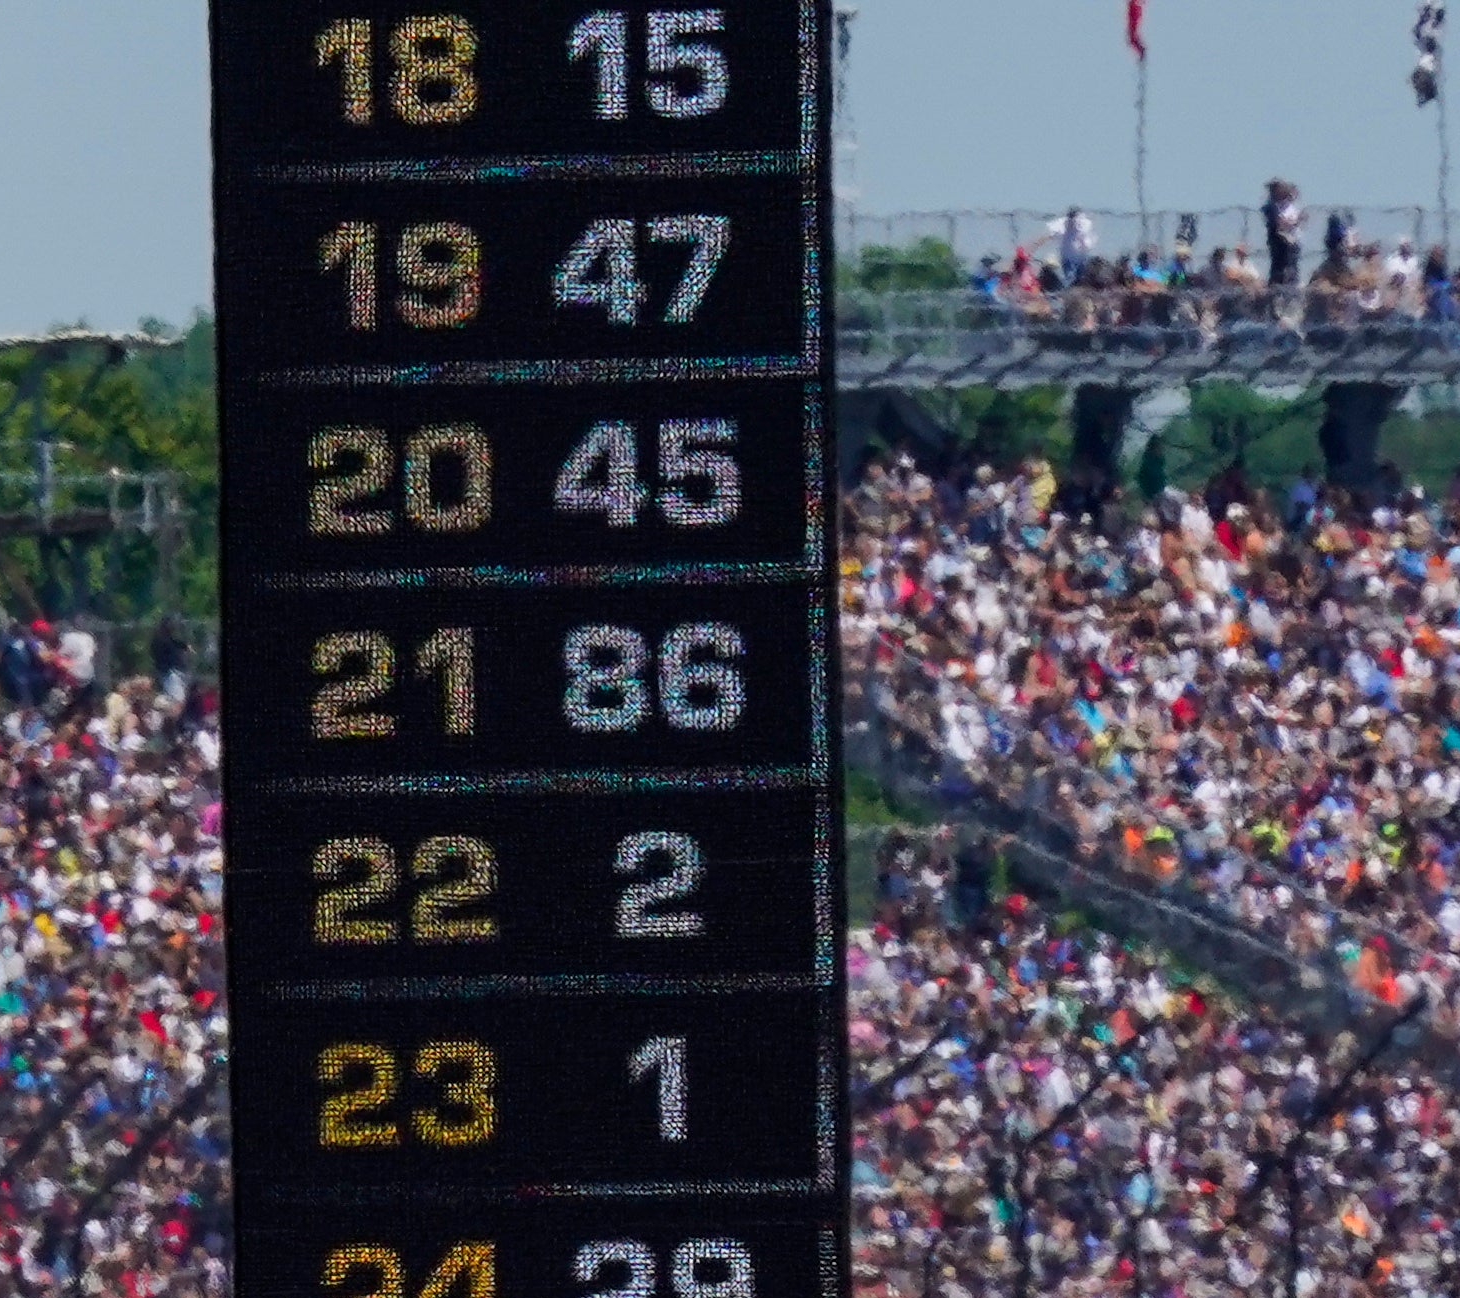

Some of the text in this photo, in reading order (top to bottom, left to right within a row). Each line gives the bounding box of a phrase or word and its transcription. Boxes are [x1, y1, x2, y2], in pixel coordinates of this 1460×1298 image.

[315, 5, 729, 123] 18 15
[322, 210, 729, 326] 19 47
[309, 416, 740, 532] 20 45
[310, 619, 746, 737] 21 86
[312, 828, 701, 942] 22 2
[318, 1034, 686, 1145] 23 1
